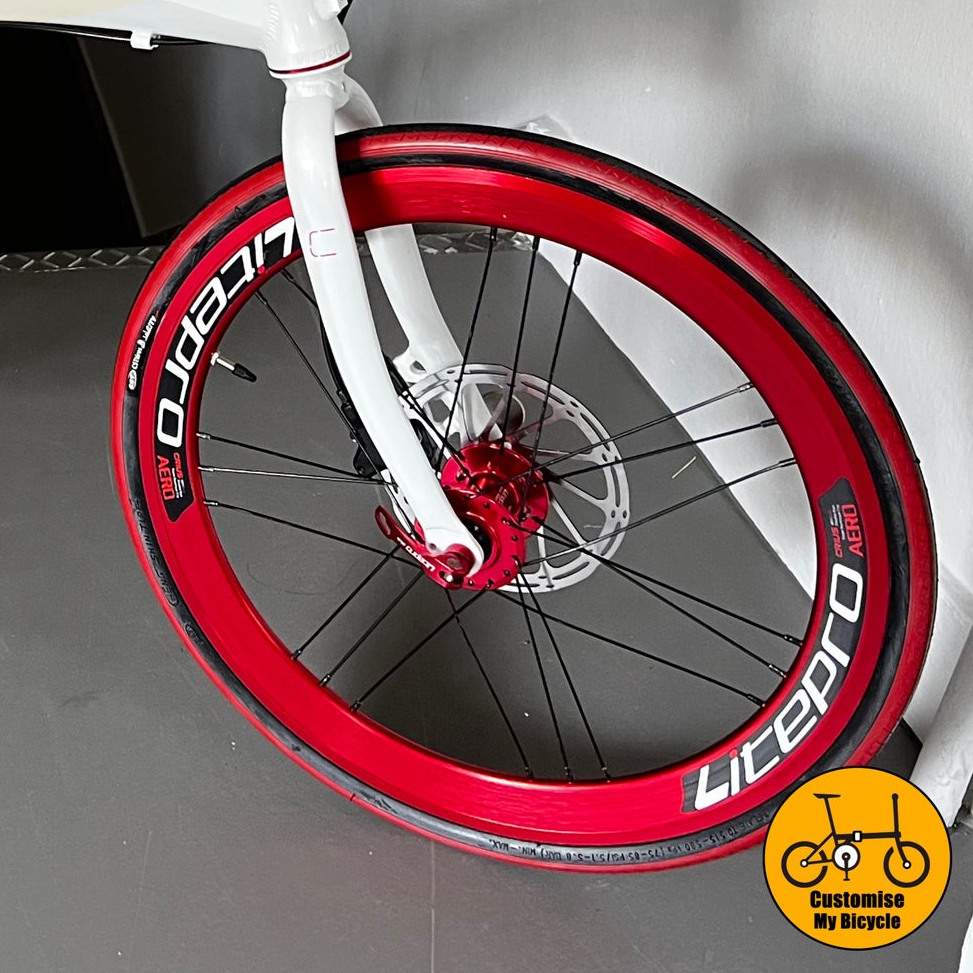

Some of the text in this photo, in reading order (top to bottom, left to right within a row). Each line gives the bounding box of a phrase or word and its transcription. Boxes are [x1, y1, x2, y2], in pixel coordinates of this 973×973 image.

[156, 216, 295, 448] Litepro
[157, 455, 175, 500] AERO
[842, 504, 864, 557] AERO
[694, 562, 864, 811] Litepro
